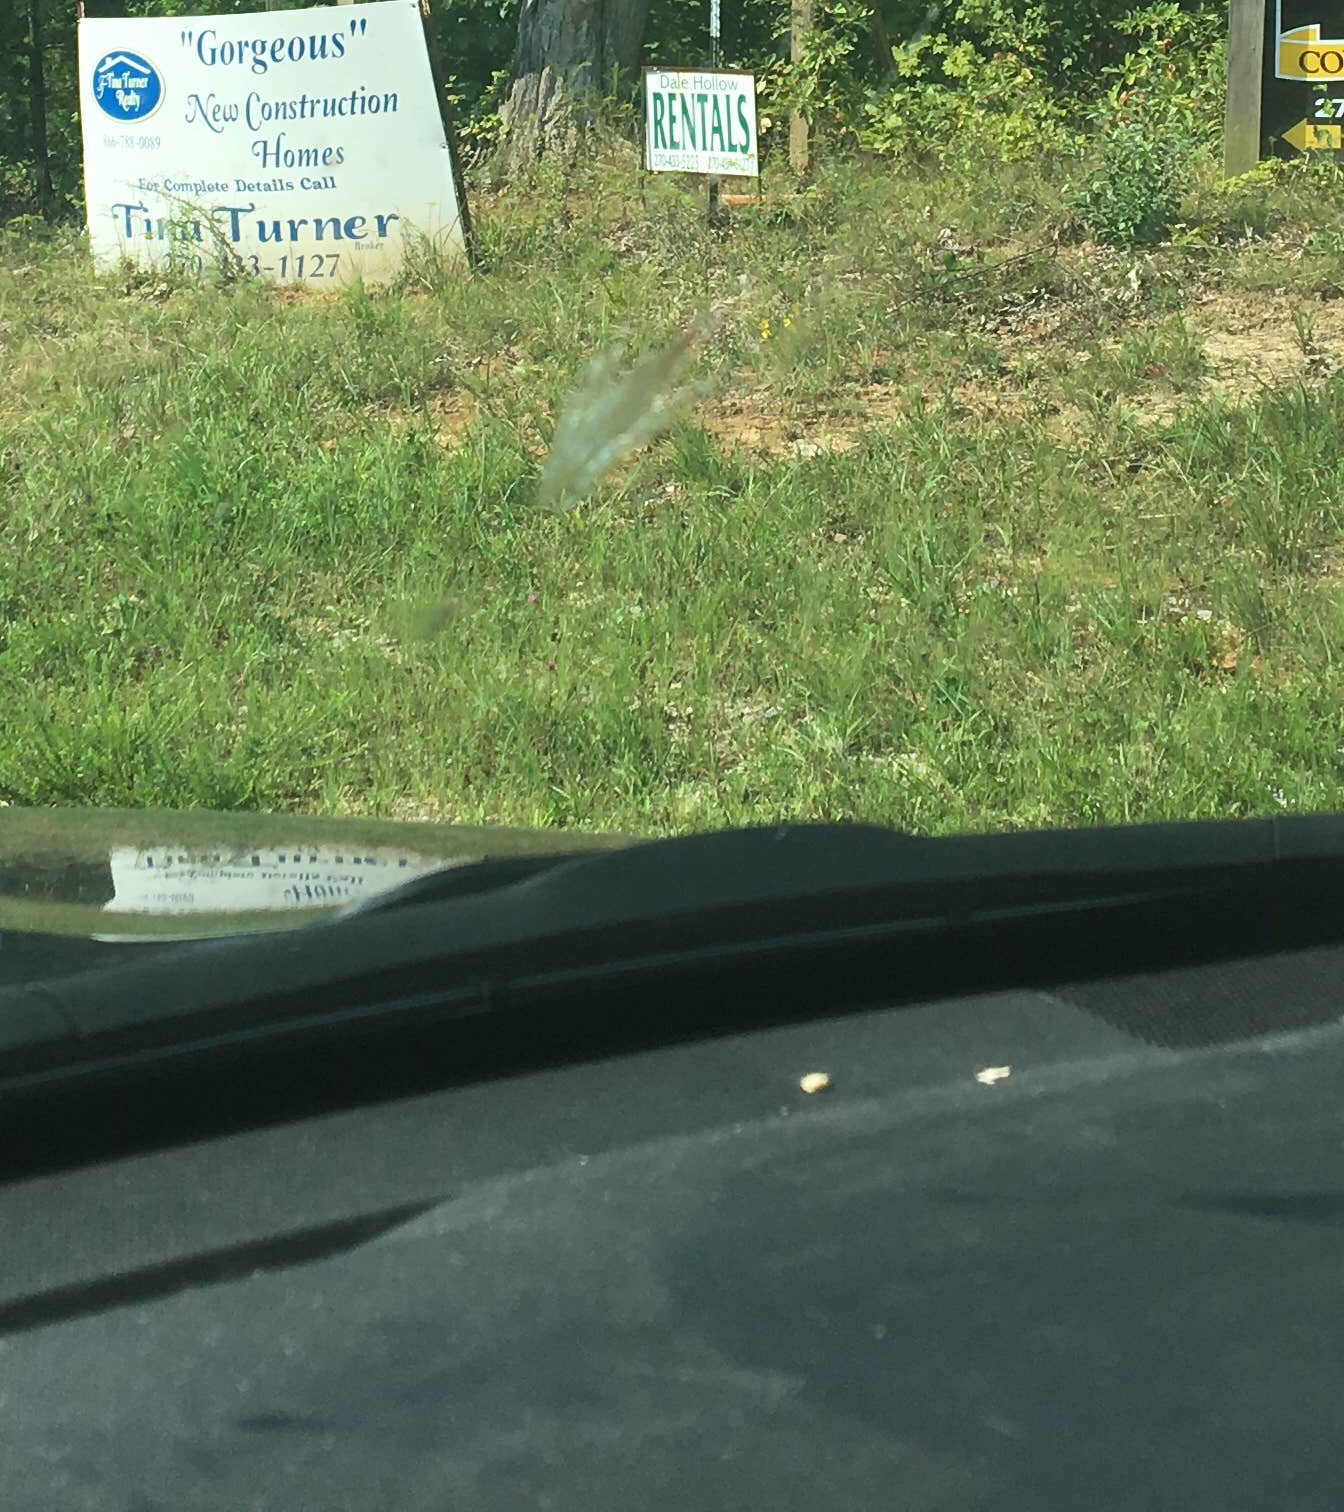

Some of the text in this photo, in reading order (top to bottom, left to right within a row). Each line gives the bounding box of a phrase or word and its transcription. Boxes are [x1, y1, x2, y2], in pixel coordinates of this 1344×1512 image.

[660, 74, 738, 91] Dale Hollow
[185, 87, 399, 134] New Construction
[652, 92, 750, 154] RENTALS
[252, 132, 345, 169] Homes
[138, 176, 337, 196] For Complete Details Call
[212, 202, 399, 243] Turner
